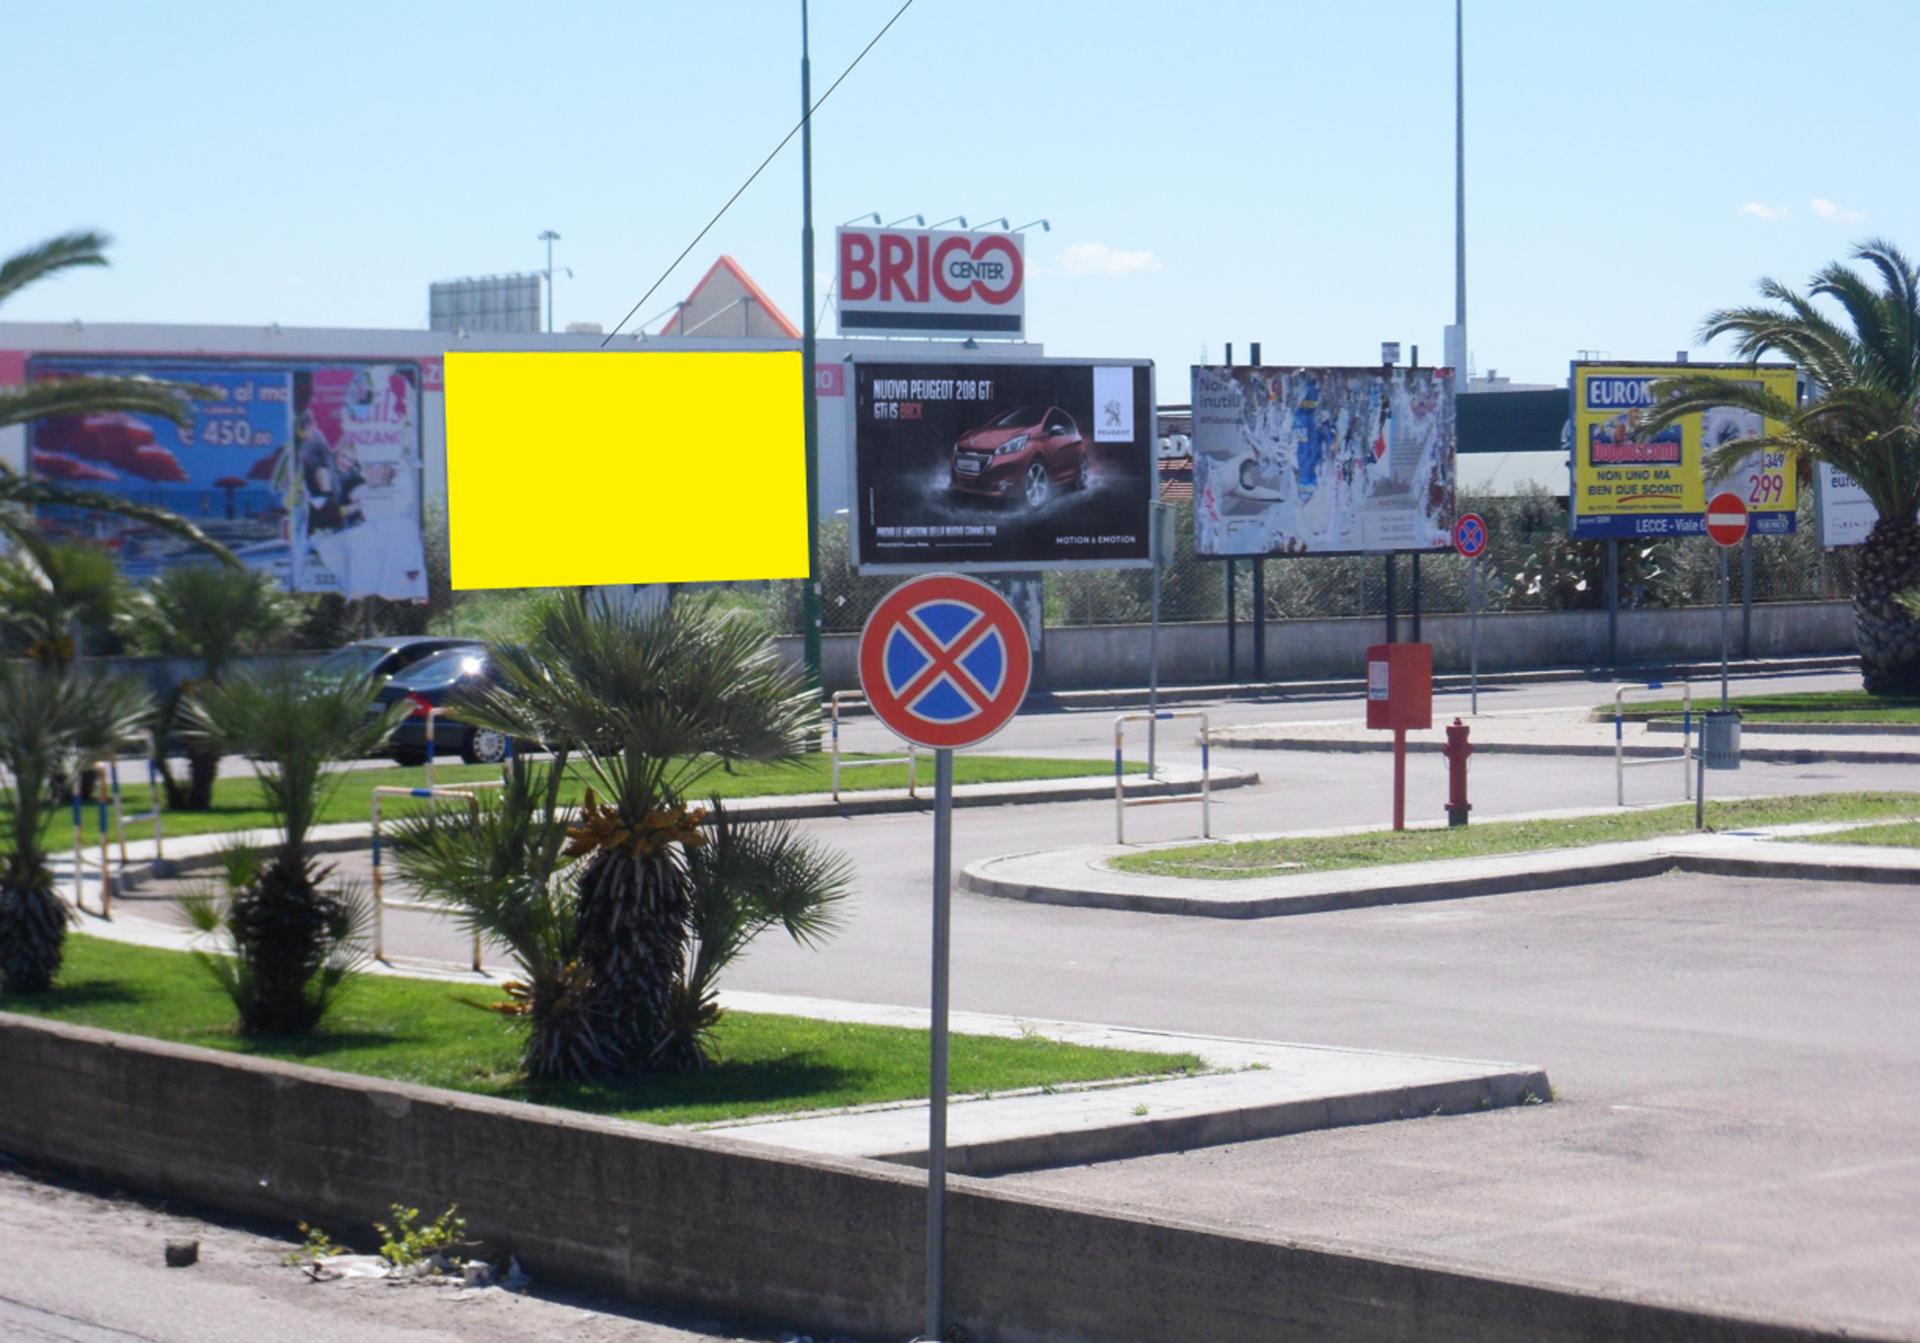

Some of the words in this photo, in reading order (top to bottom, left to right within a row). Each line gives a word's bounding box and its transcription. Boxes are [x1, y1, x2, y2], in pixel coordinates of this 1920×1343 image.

[841, 232, 1023, 305] BRICO
[950, 260, 1004, 280] CENTER
[873, 379, 909, 400] NUOVA
[910, 380, 954, 400] PEUGEOT
[956, 381, 977, 400] 208
[1597, 470, 1622, 480] NON
[1626, 470, 1650, 480] UNO
[1654, 469, 1671, 479] MA
[1588, 485, 1612, 495] BEN
[1616, 484, 1638, 495] DUE
[1642, 483, 1683, 494] SCONTI
[1748, 474, 1783, 503] 299
[1636, 519, 1668, 533] LECCE
[1676, 518, 1698, 531] Viale
[1056, 535, 1089, 544] MOTION
[1098, 535, 1136, 544] EMOTION
